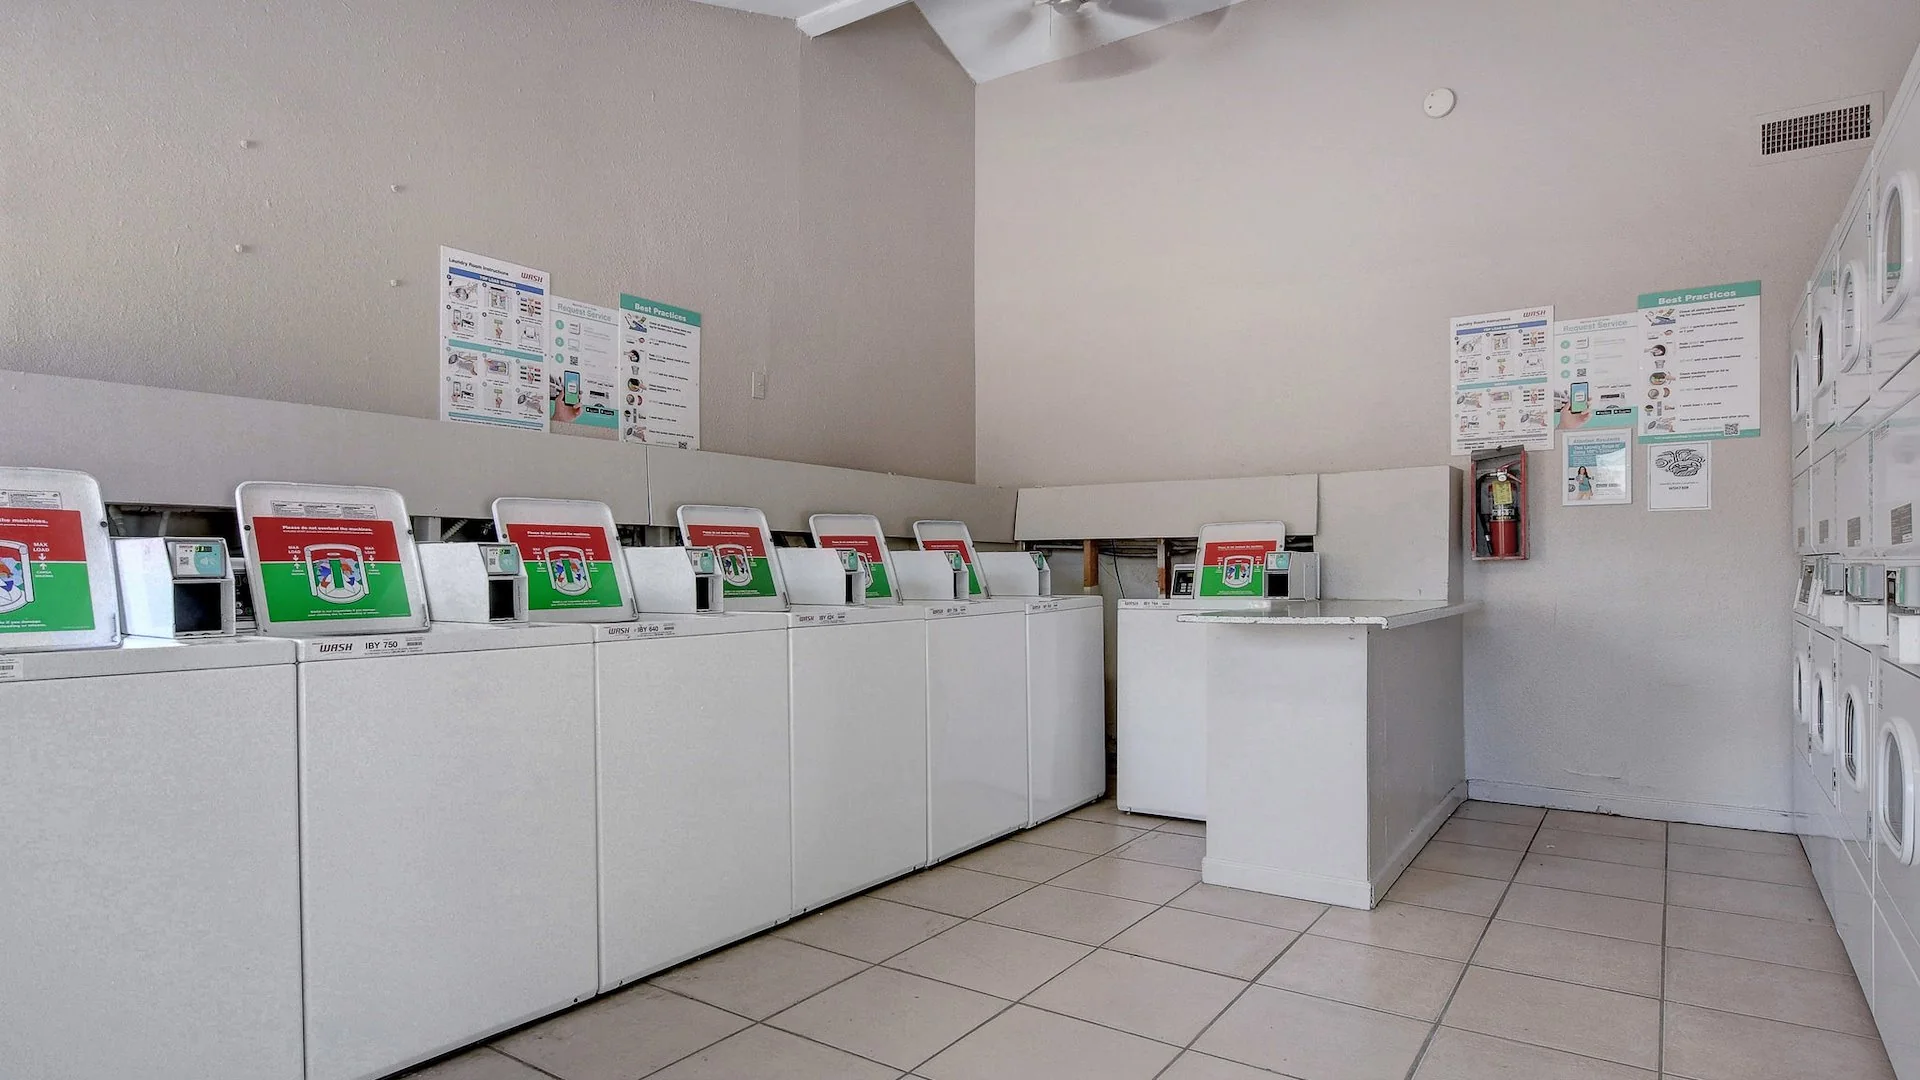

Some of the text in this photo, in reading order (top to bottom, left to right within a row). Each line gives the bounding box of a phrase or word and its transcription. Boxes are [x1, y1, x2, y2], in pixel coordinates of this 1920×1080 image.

[449, 257, 468, 267] Laundry
[520, 272, 543, 283] WASH
[1658, 290, 1736, 305] Best Practices
[557, 303, 586, 315] Request
[587, 310, 611, 321] Service
[634, 302, 687, 322] Best Practices
[1522, 310, 1547, 318] WASH
[1563, 320, 1628, 332] Request Service
[608, 627, 630, 635] WASH
[319, 640, 398, 653] WASH IBY 750
